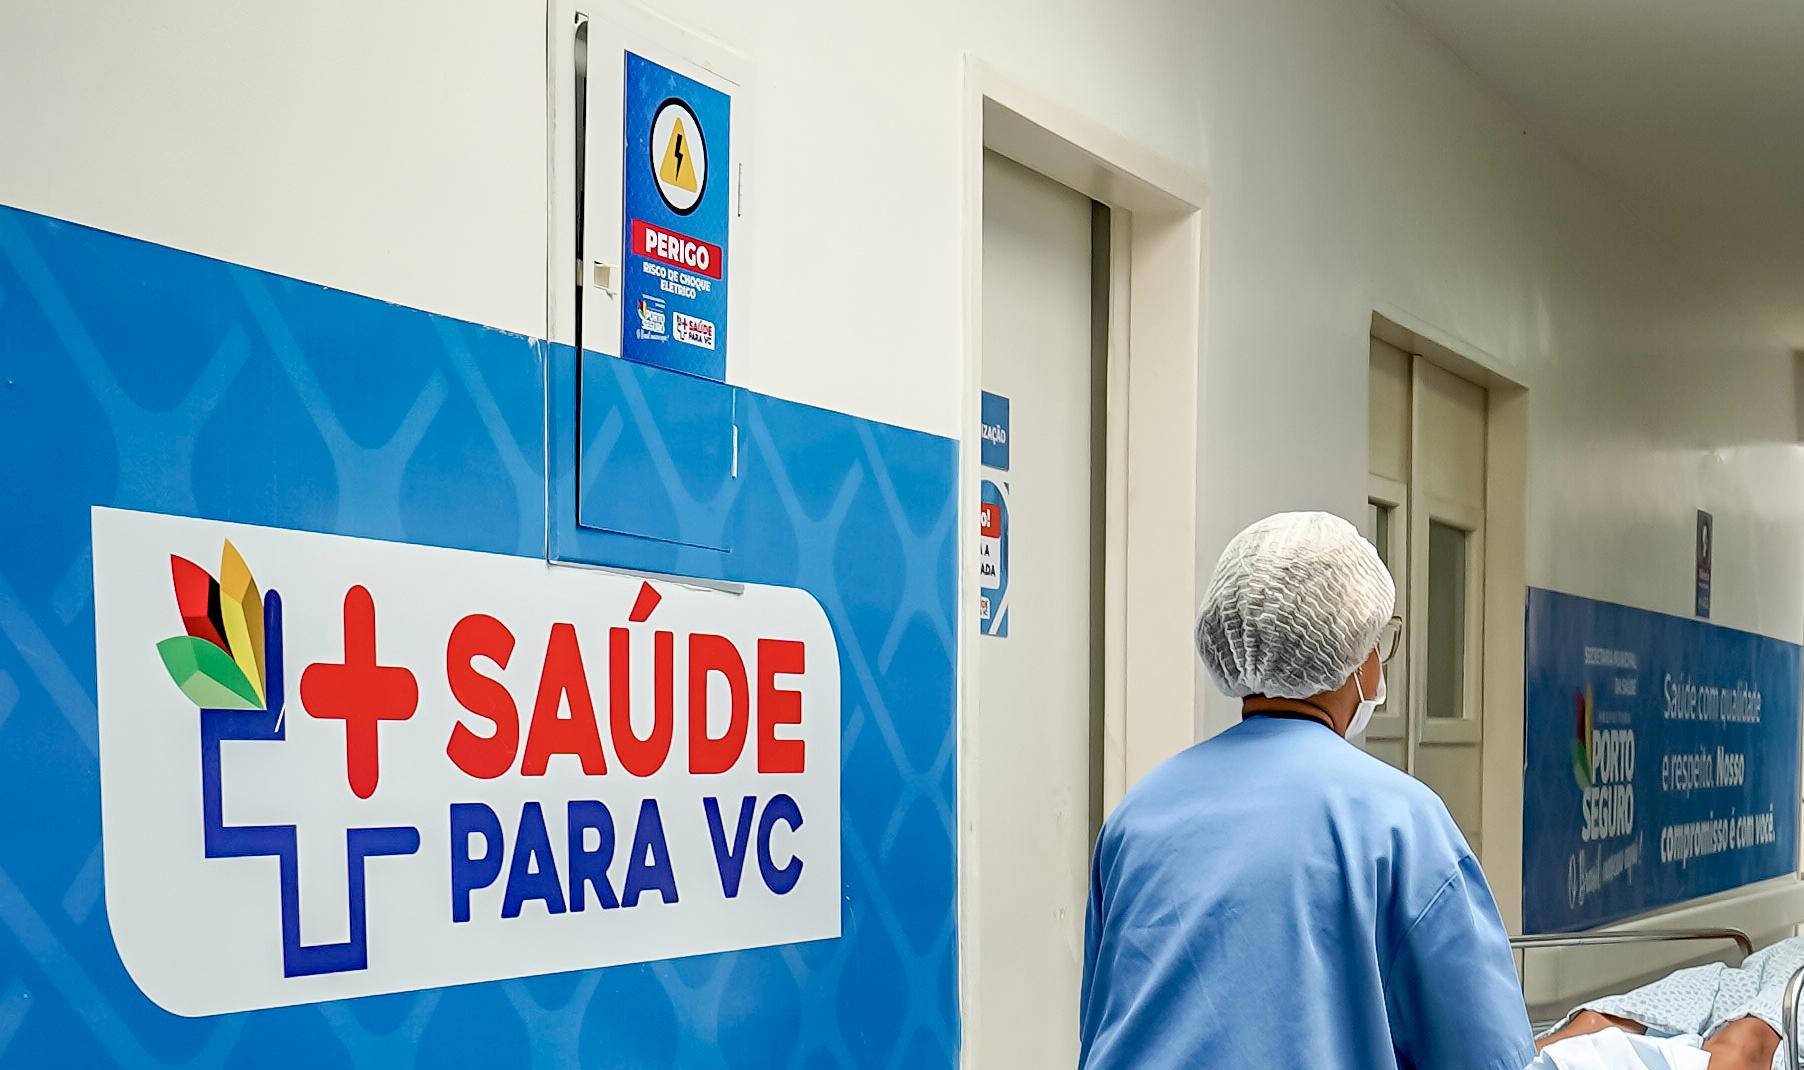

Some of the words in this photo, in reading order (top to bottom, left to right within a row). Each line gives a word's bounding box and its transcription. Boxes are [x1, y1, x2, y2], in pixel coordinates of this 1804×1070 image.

[645, 227, 710, 271] PERIGO
[445, 580, 806, 780] SAÚDE
[1664, 672, 1697, 720] Saúde
[1592, 729, 1636, 784] PORTO
[1662, 754, 1669, 792] e
[1715, 745, 1745, 787] Nosso
[1581, 783, 1635, 843] SEGURO
[1660, 809, 1728, 870] compromisso
[450, 797, 680, 924] PARA
[702, 793, 805, 898] VC
